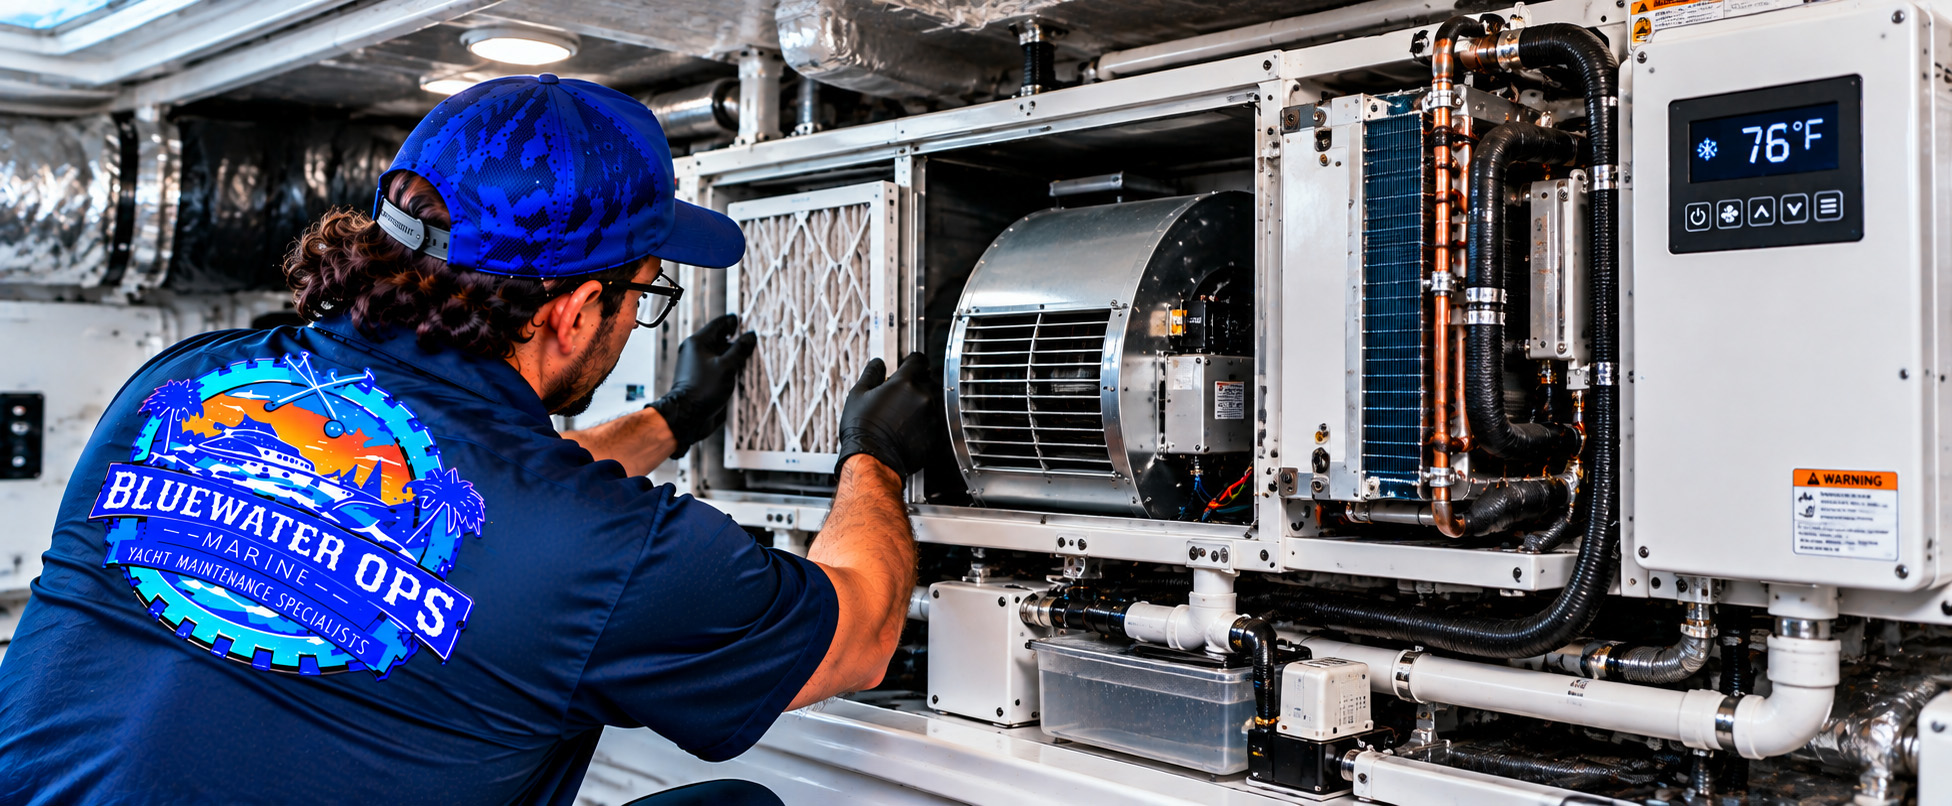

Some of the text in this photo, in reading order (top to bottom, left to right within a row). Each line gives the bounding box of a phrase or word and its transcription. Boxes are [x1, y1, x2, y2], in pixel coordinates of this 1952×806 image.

[1822, 473, 1883, 487] WARNING
[103, 471, 455, 638] BLUEWATER OPS
[201, 531, 310, 586] MARINE
[127, 546, 370, 655] YACHT MAINTENANCE SPECIALISTS
